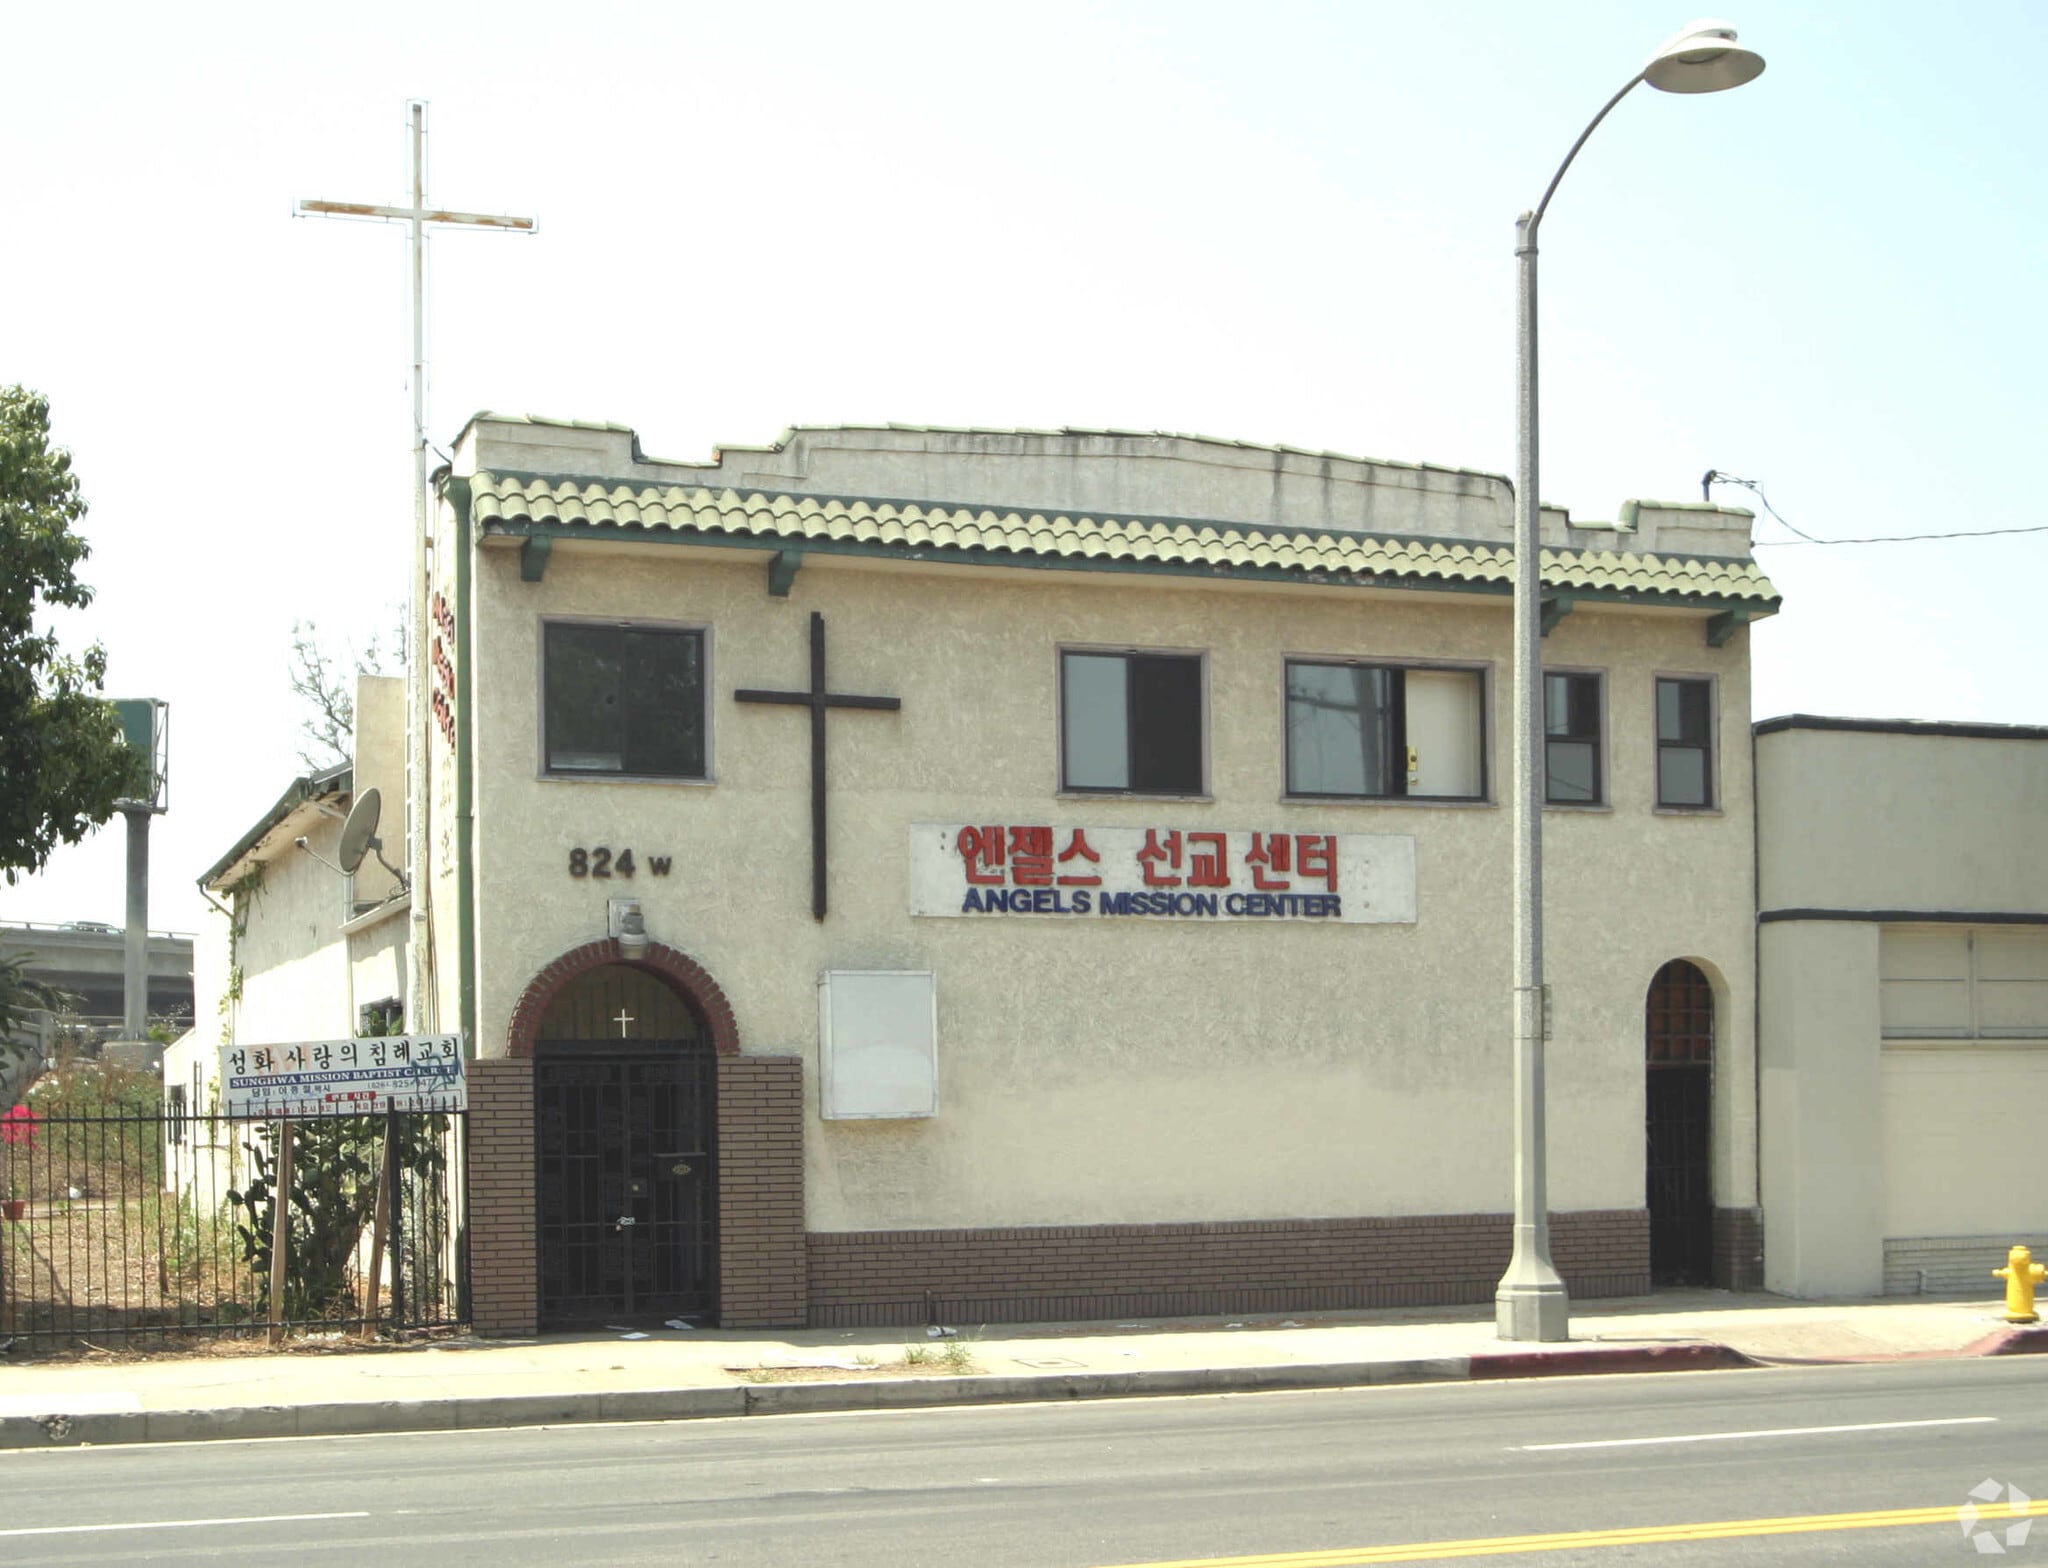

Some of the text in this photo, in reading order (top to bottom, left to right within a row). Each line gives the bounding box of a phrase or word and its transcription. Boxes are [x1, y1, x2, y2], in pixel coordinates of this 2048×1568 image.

[568, 847, 636, 879] 824
[957, 825, 1338, 893] 엔젤스 선교 센터
[961, 887, 1342, 917] ANGELS MISSION CENTER
[228, 1037, 458, 1075] 성화 사랑의 침례교회
[231, 1066, 455, 1088] SUNGHWA MISSION BAPTIST CURH
